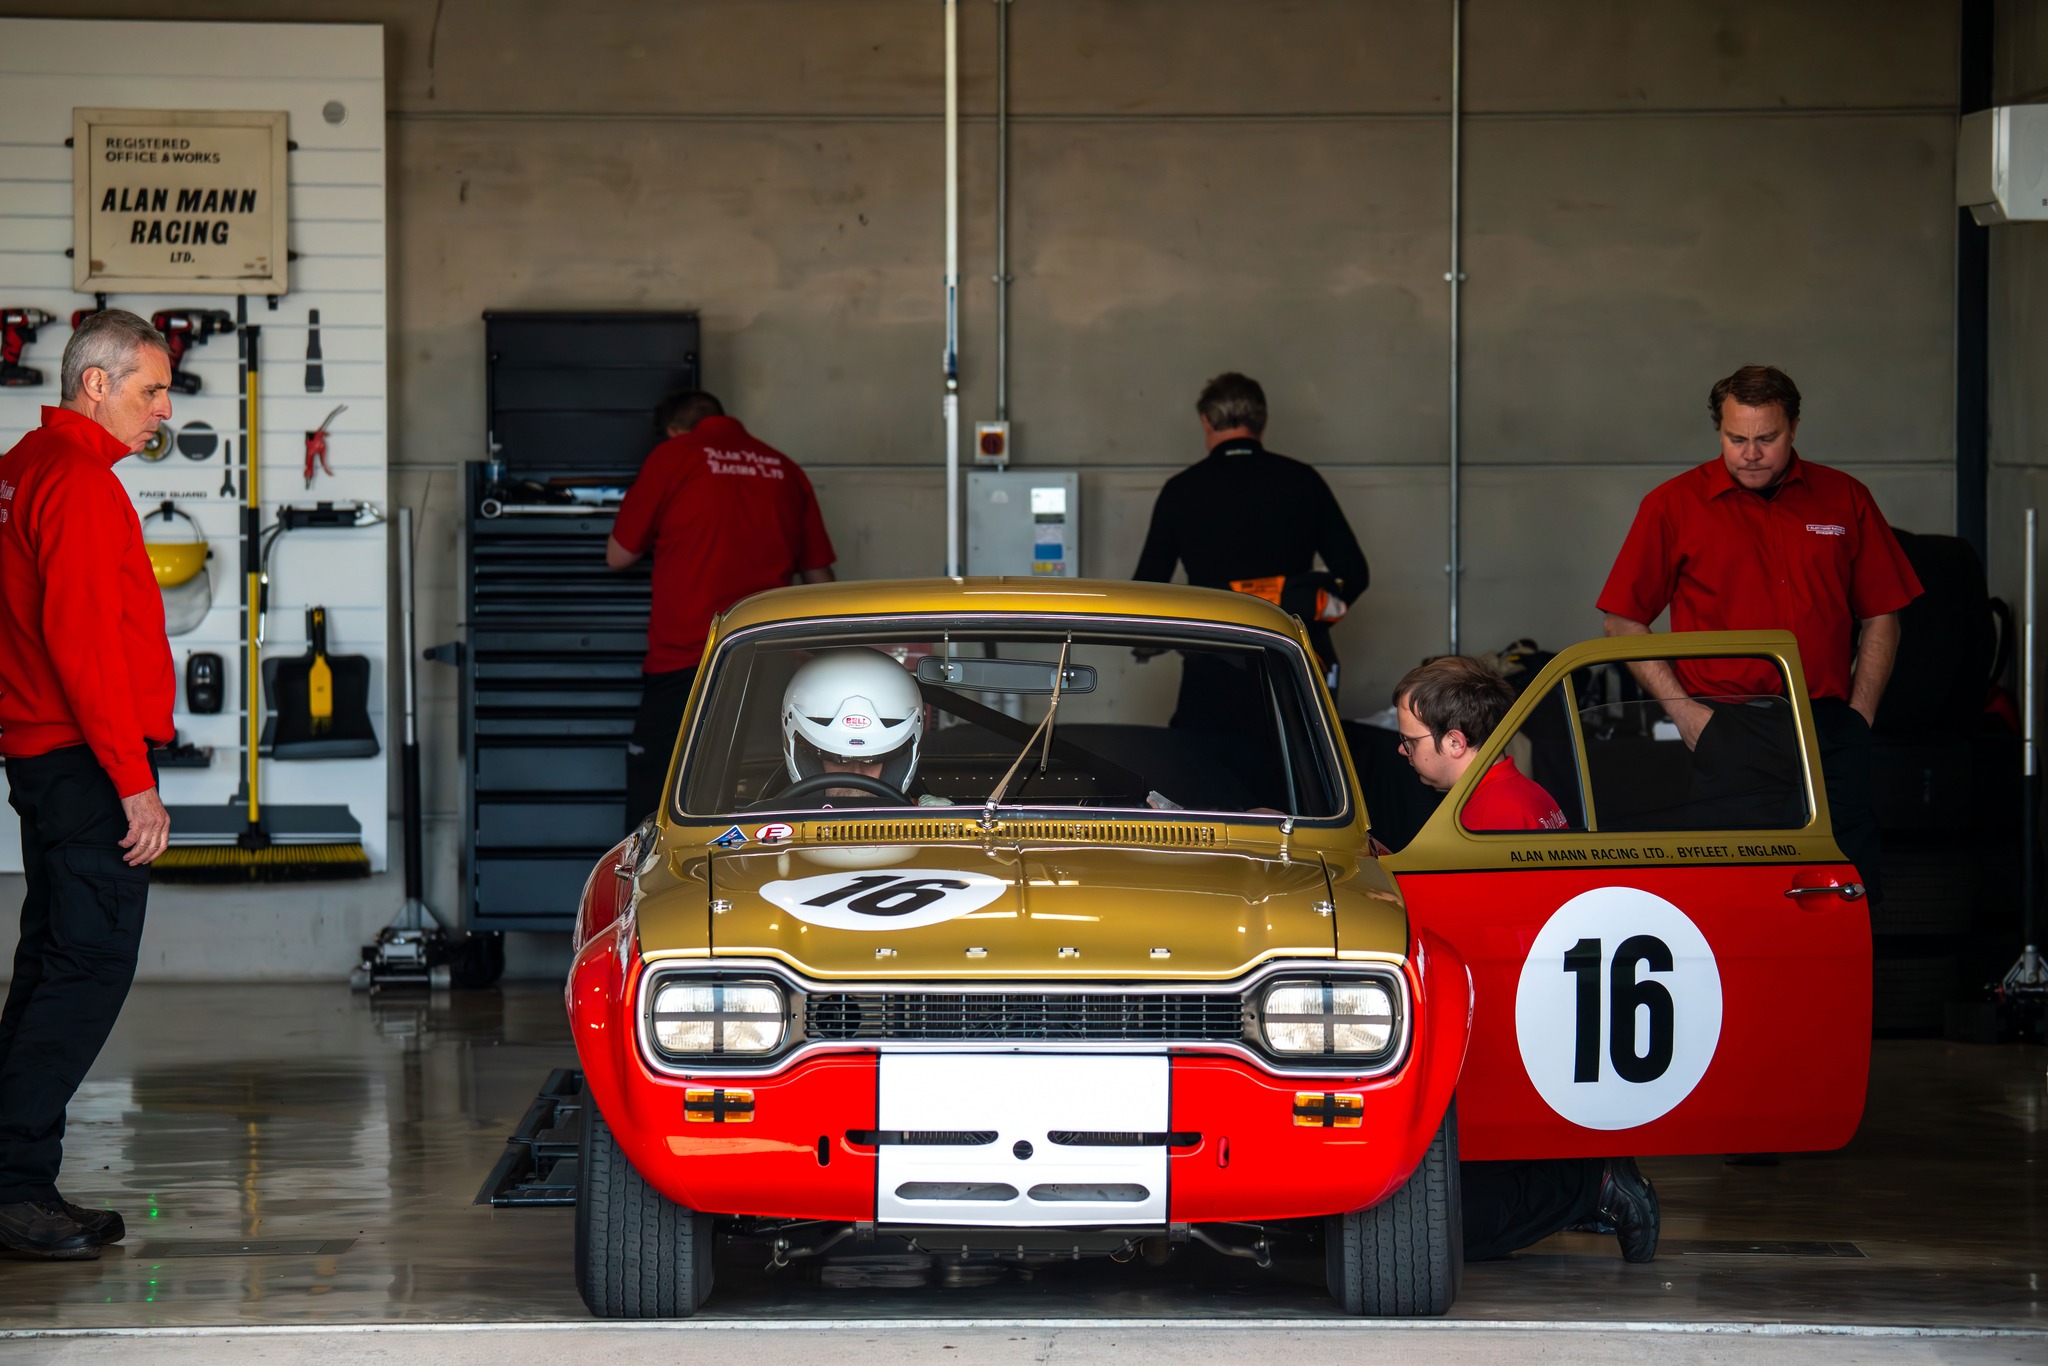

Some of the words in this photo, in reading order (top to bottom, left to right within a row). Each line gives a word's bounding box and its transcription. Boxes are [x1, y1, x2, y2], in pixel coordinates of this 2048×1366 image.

[106, 138, 190, 149] REGISTERED
[105, 151, 158, 163] OFFICE
[161, 153, 170, 163] &
[173, 152, 221, 163] WORKS
[101, 188, 168, 212] ALAN
[176, 188, 257, 213] MANN
[130, 220, 229, 245] RACING
[170, 252, 195, 263] LTD.
[764, 827, 785, 839] E
[1510, 851, 1544, 862] ALAN
[1548, 849, 1587, 861] MANN
[1591, 848, 1639, 860] RACING
[1643, 848, 1674, 859] LTD.,
[1677, 846, 1734, 858] BYFLEET,
[1737, 845, 1801, 857] ENGLAND.
[799, 875, 971, 917] 16
[1563, 934, 1674, 1083] 16
